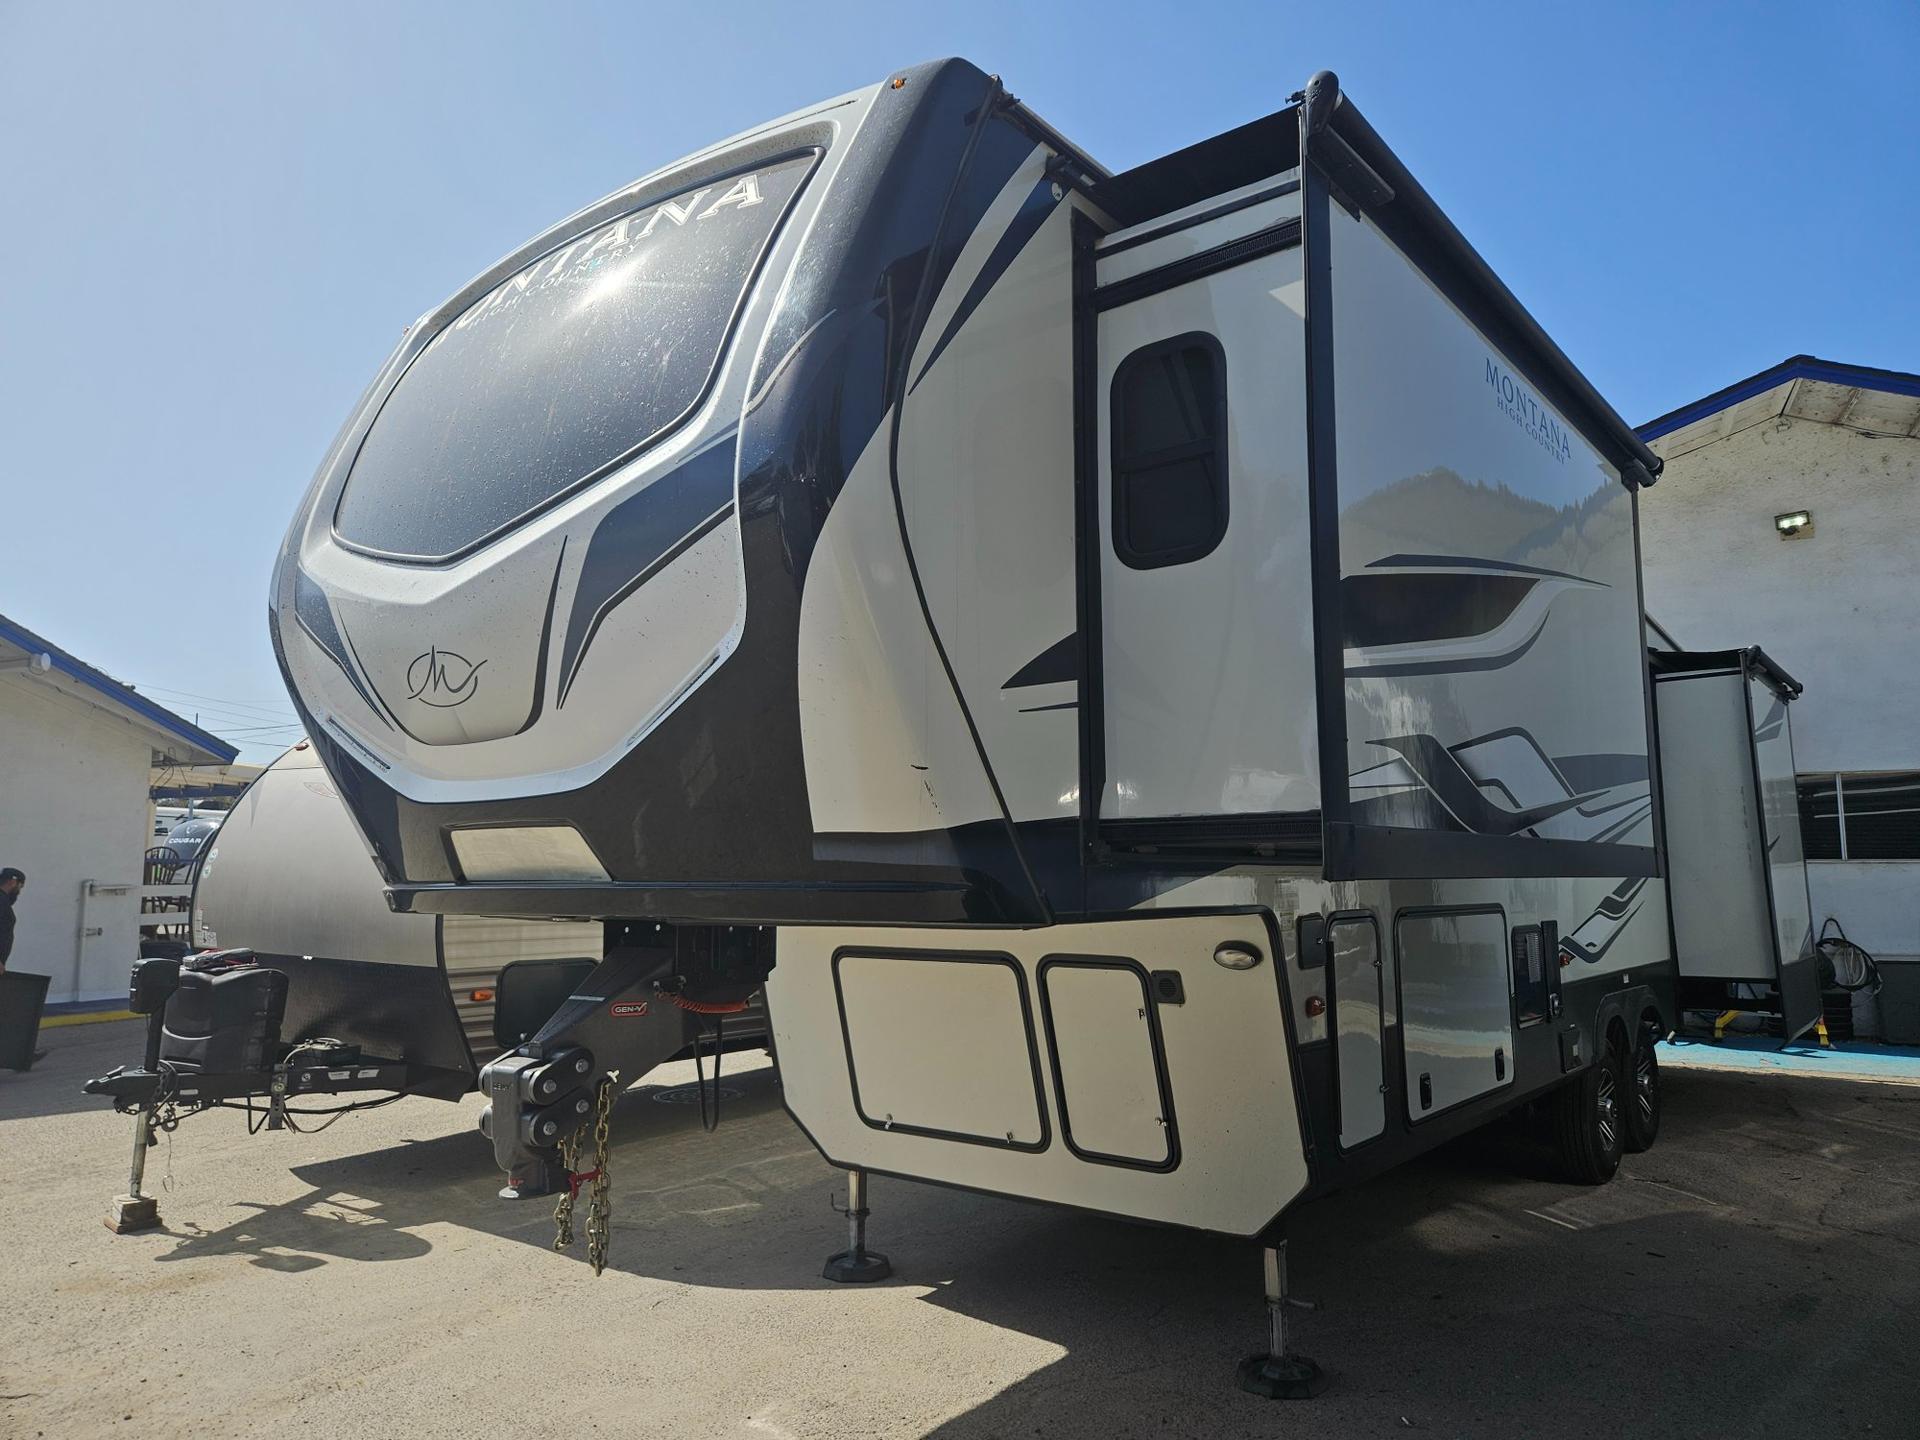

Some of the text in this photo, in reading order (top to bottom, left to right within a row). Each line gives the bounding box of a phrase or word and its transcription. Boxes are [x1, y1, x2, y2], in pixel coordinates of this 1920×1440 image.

[1486, 357, 1571, 459] MONTANA
[1497, 397, 1565, 465] HIGH COUNTRY
[614, 1002, 648, 1013] GEN-Y
